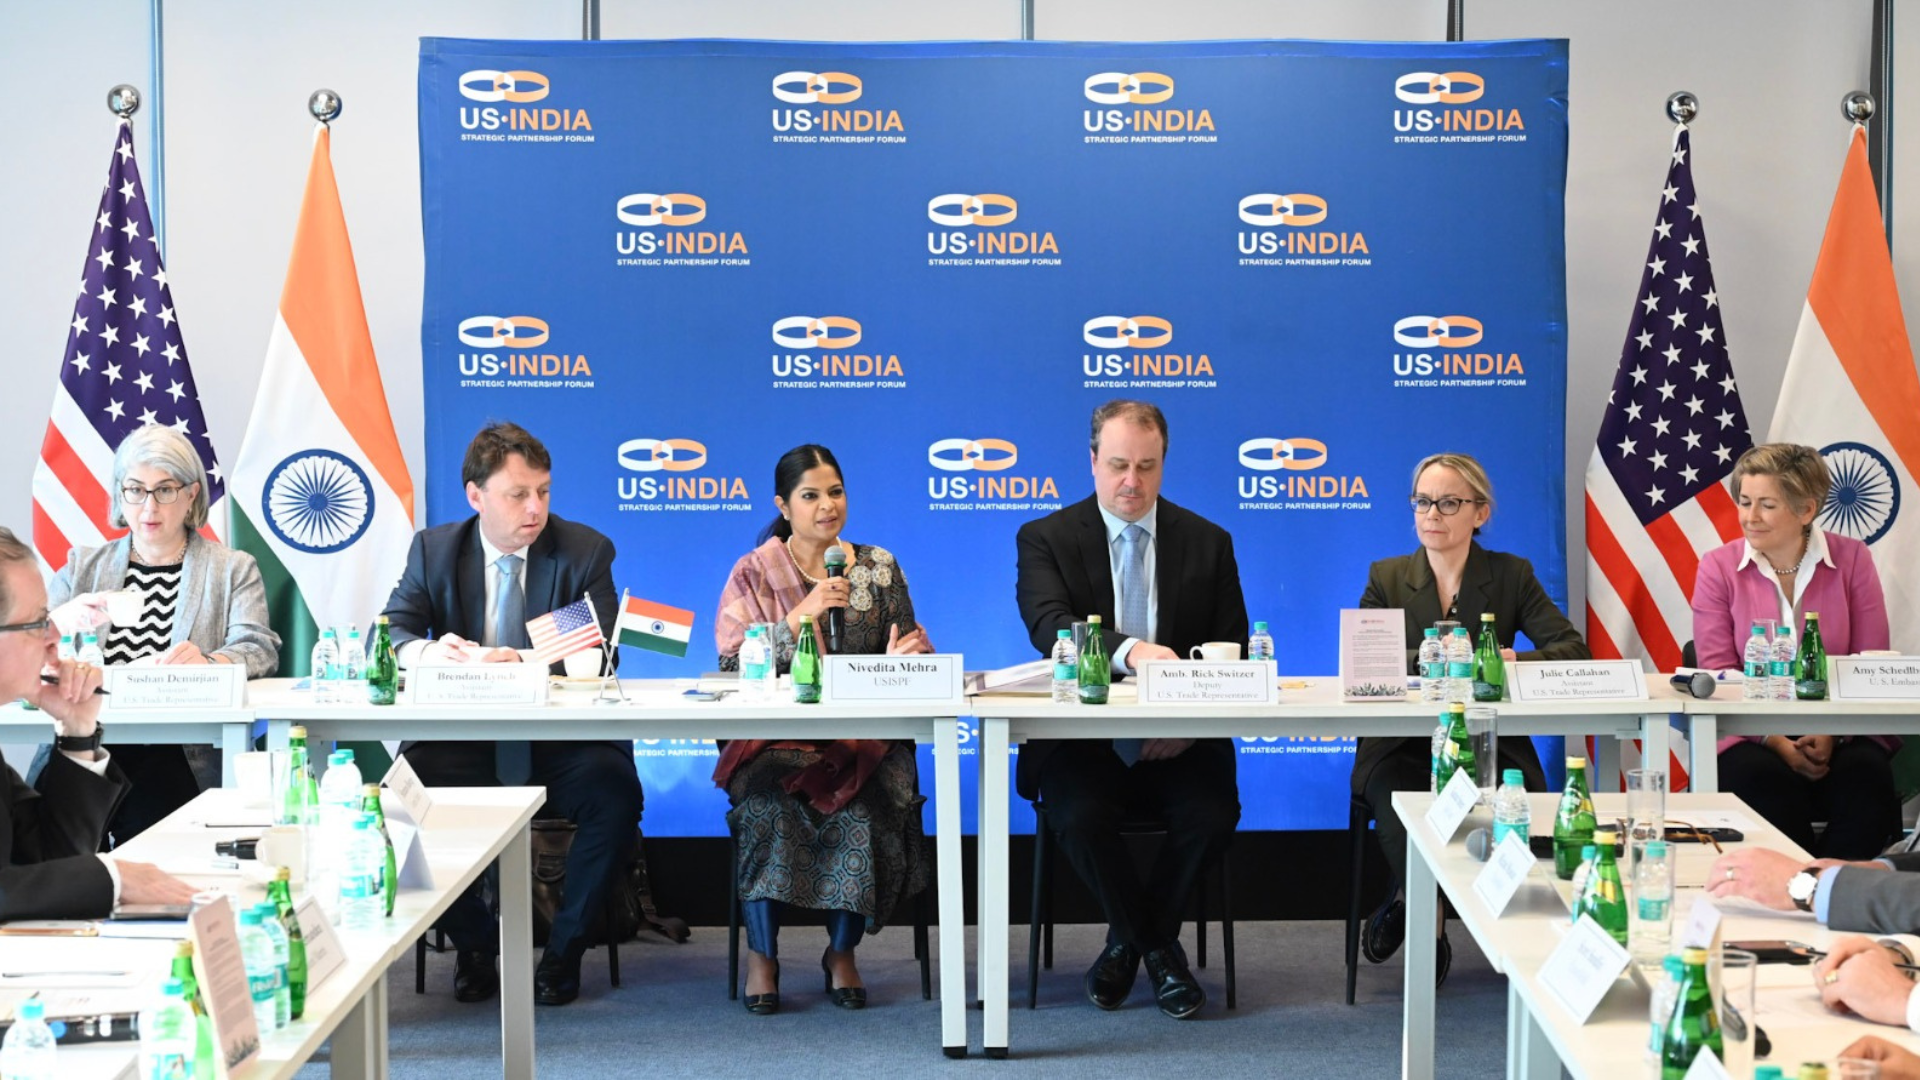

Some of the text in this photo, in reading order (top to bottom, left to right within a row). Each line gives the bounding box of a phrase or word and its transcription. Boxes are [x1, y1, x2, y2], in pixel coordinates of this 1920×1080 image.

[460, 133, 594, 142] STRATEGIC PARTNERSHIP FORUM
[772, 135, 906, 143] STRATEGIC PARTNERSHIP FORUM
[1083, 135, 1217, 143] STRATEGIC PARTNERSHIP FORUM
[1394, 134, 1526, 143] STRATEGIC PARTNERSHIP FORUM
[460, 379, 594, 387] STRATEGIC PARTNERSHIP FORUM
[772, 380, 906, 388] STRATEGIC PARTNERSHIP FORUM
[848, 662, 938, 673] Nivedita Mehra
[1853, 666, 1875, 677] Amy
[437, 672, 481, 681] Brendan
[1160, 669, 1255, 678] Amb. Rick Switzer
[1540, 668, 1611, 679] Julie Callahan
[127, 674, 164, 684] Sushan
[1177, 691, 1198, 699] Trade
[1240, 746, 1284, 754] STRATEGIC
[1286, 746, 1341, 754] PARTNERSHIP
